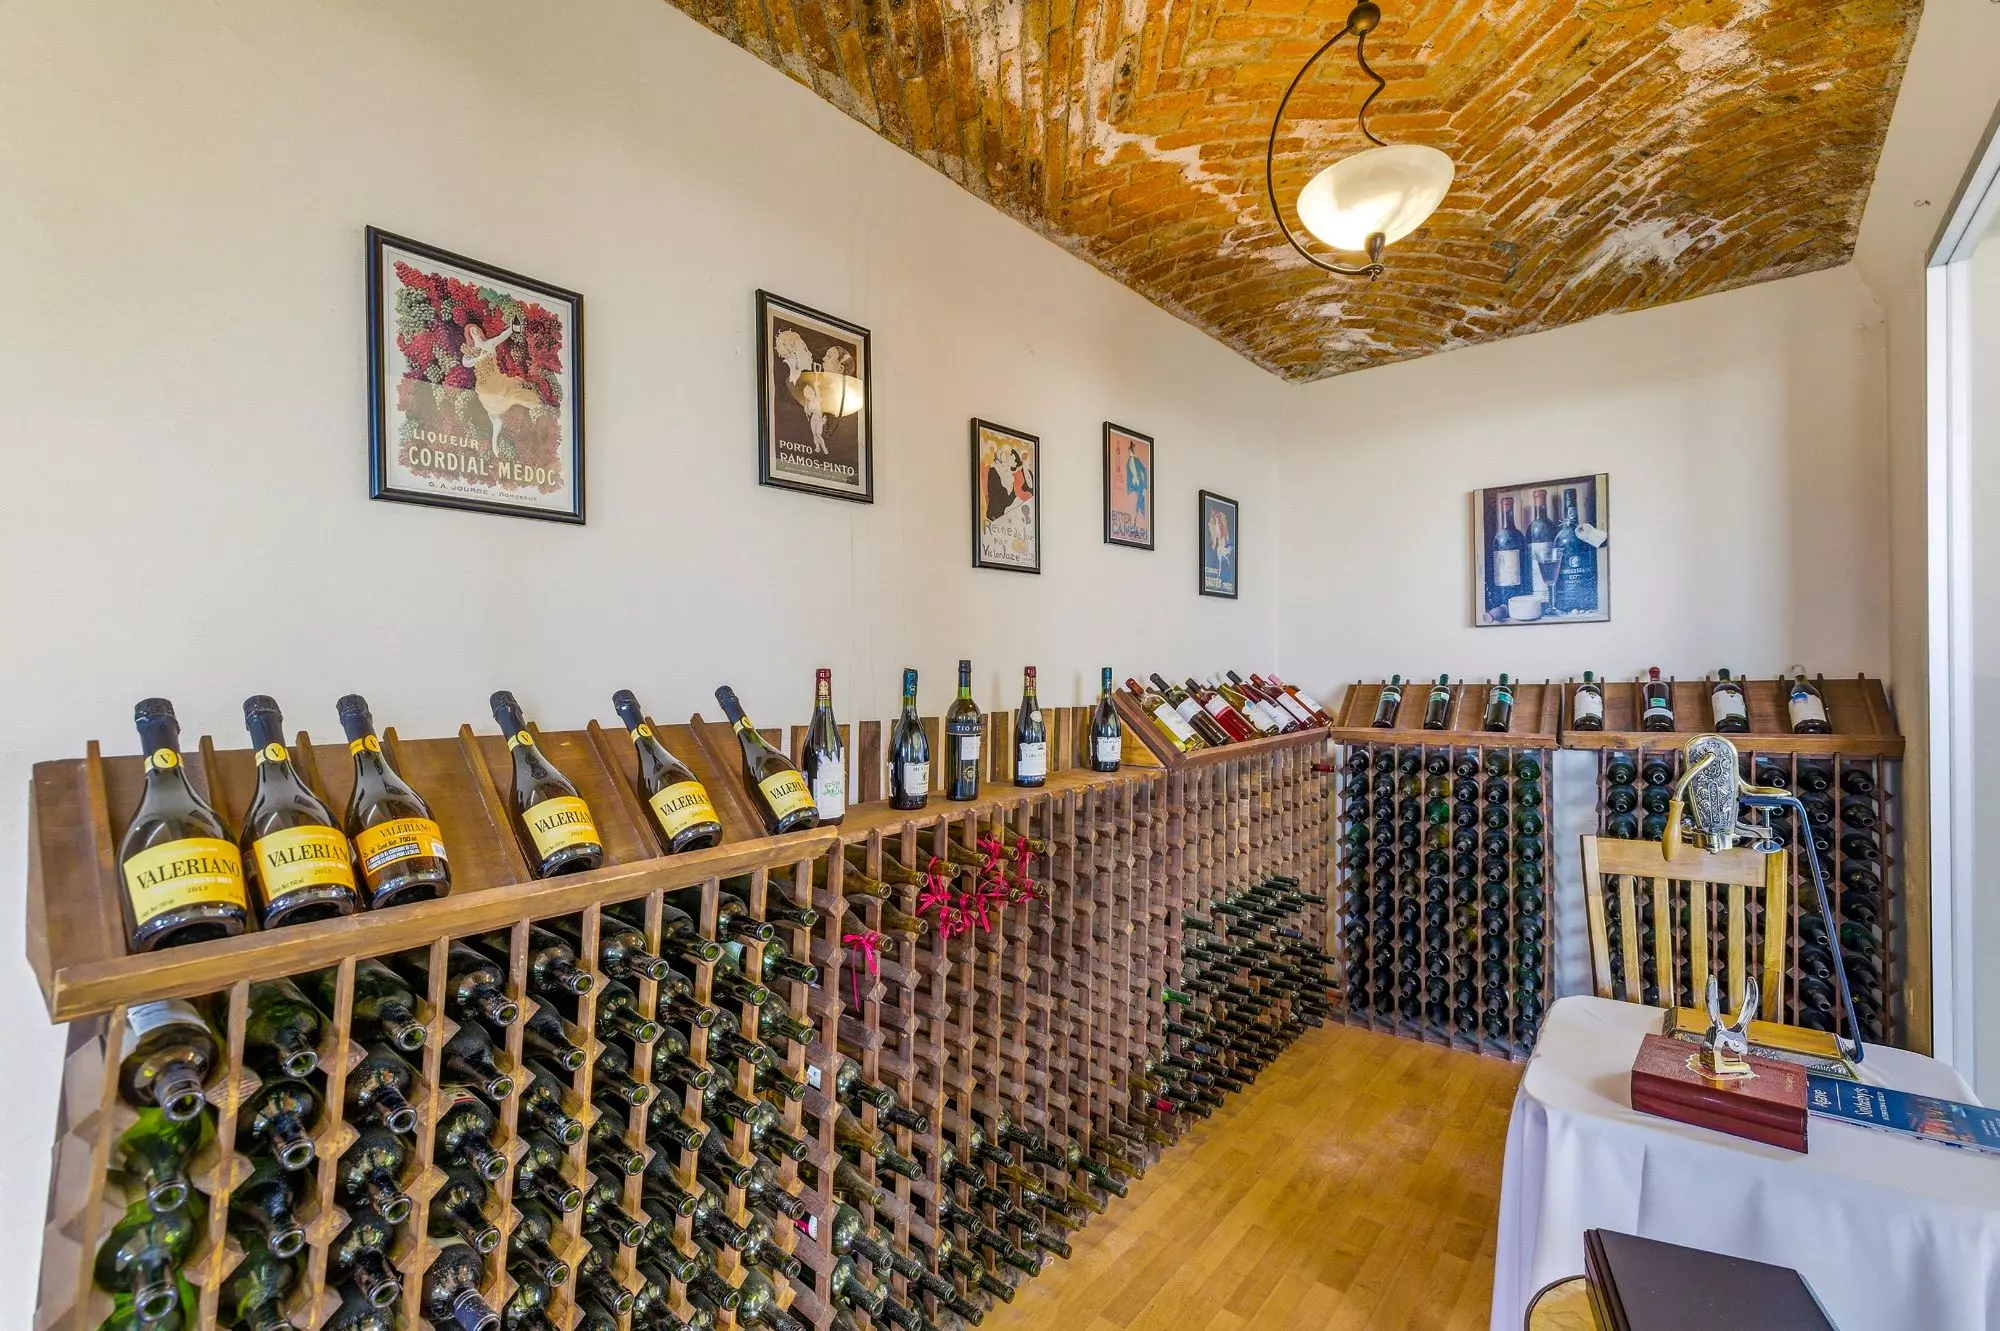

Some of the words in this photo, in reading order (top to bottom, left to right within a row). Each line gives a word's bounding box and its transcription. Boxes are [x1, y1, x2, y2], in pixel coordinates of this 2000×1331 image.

[413, 428, 479, 450] LIQUEUR
[780, 440, 813, 454] PORTO
[780, 452, 855, 476] RAMOS-PINTO
[984, 519, 1013, 537] Reine
[380, 822, 432, 838] VALERIANO
[137, 857, 240, 889] VALERIANO
[1812, 1089, 1832, 1108] Agave
[1852, 1087, 1874, 1117] Sotheby's
